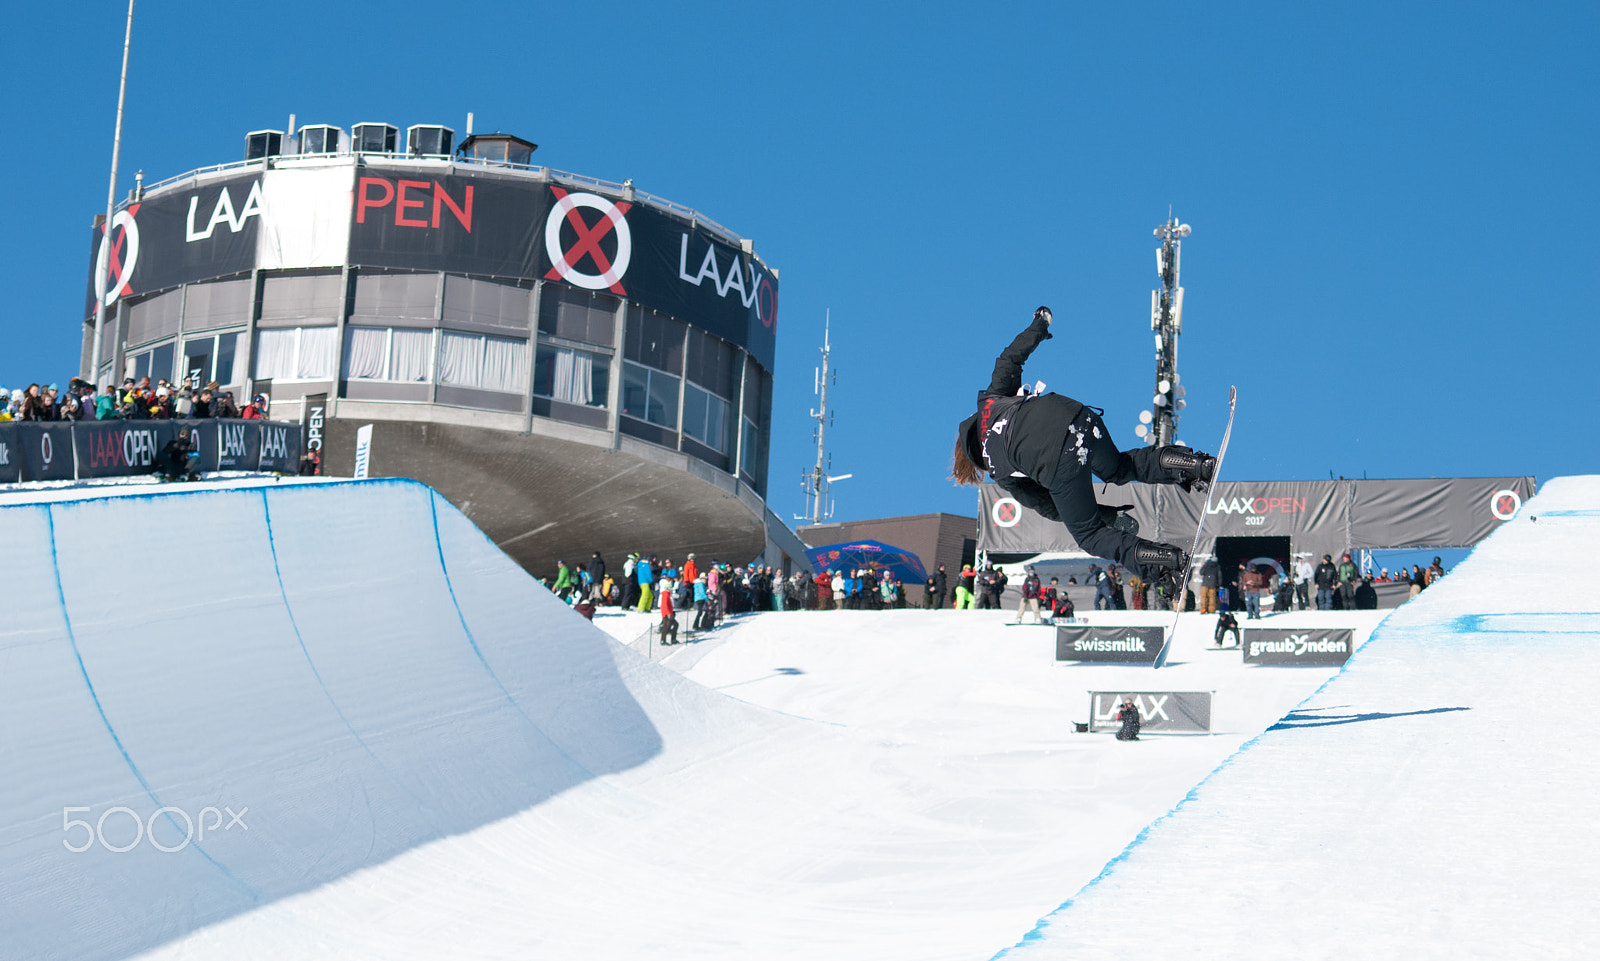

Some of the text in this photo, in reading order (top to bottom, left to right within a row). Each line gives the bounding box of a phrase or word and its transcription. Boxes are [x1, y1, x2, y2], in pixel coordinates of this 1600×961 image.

[1207, 496, 1306, 514] LAAXOPEN
[1245, 515, 1265, 526] 2017
[1073, 636, 1146, 653] swissmilk
